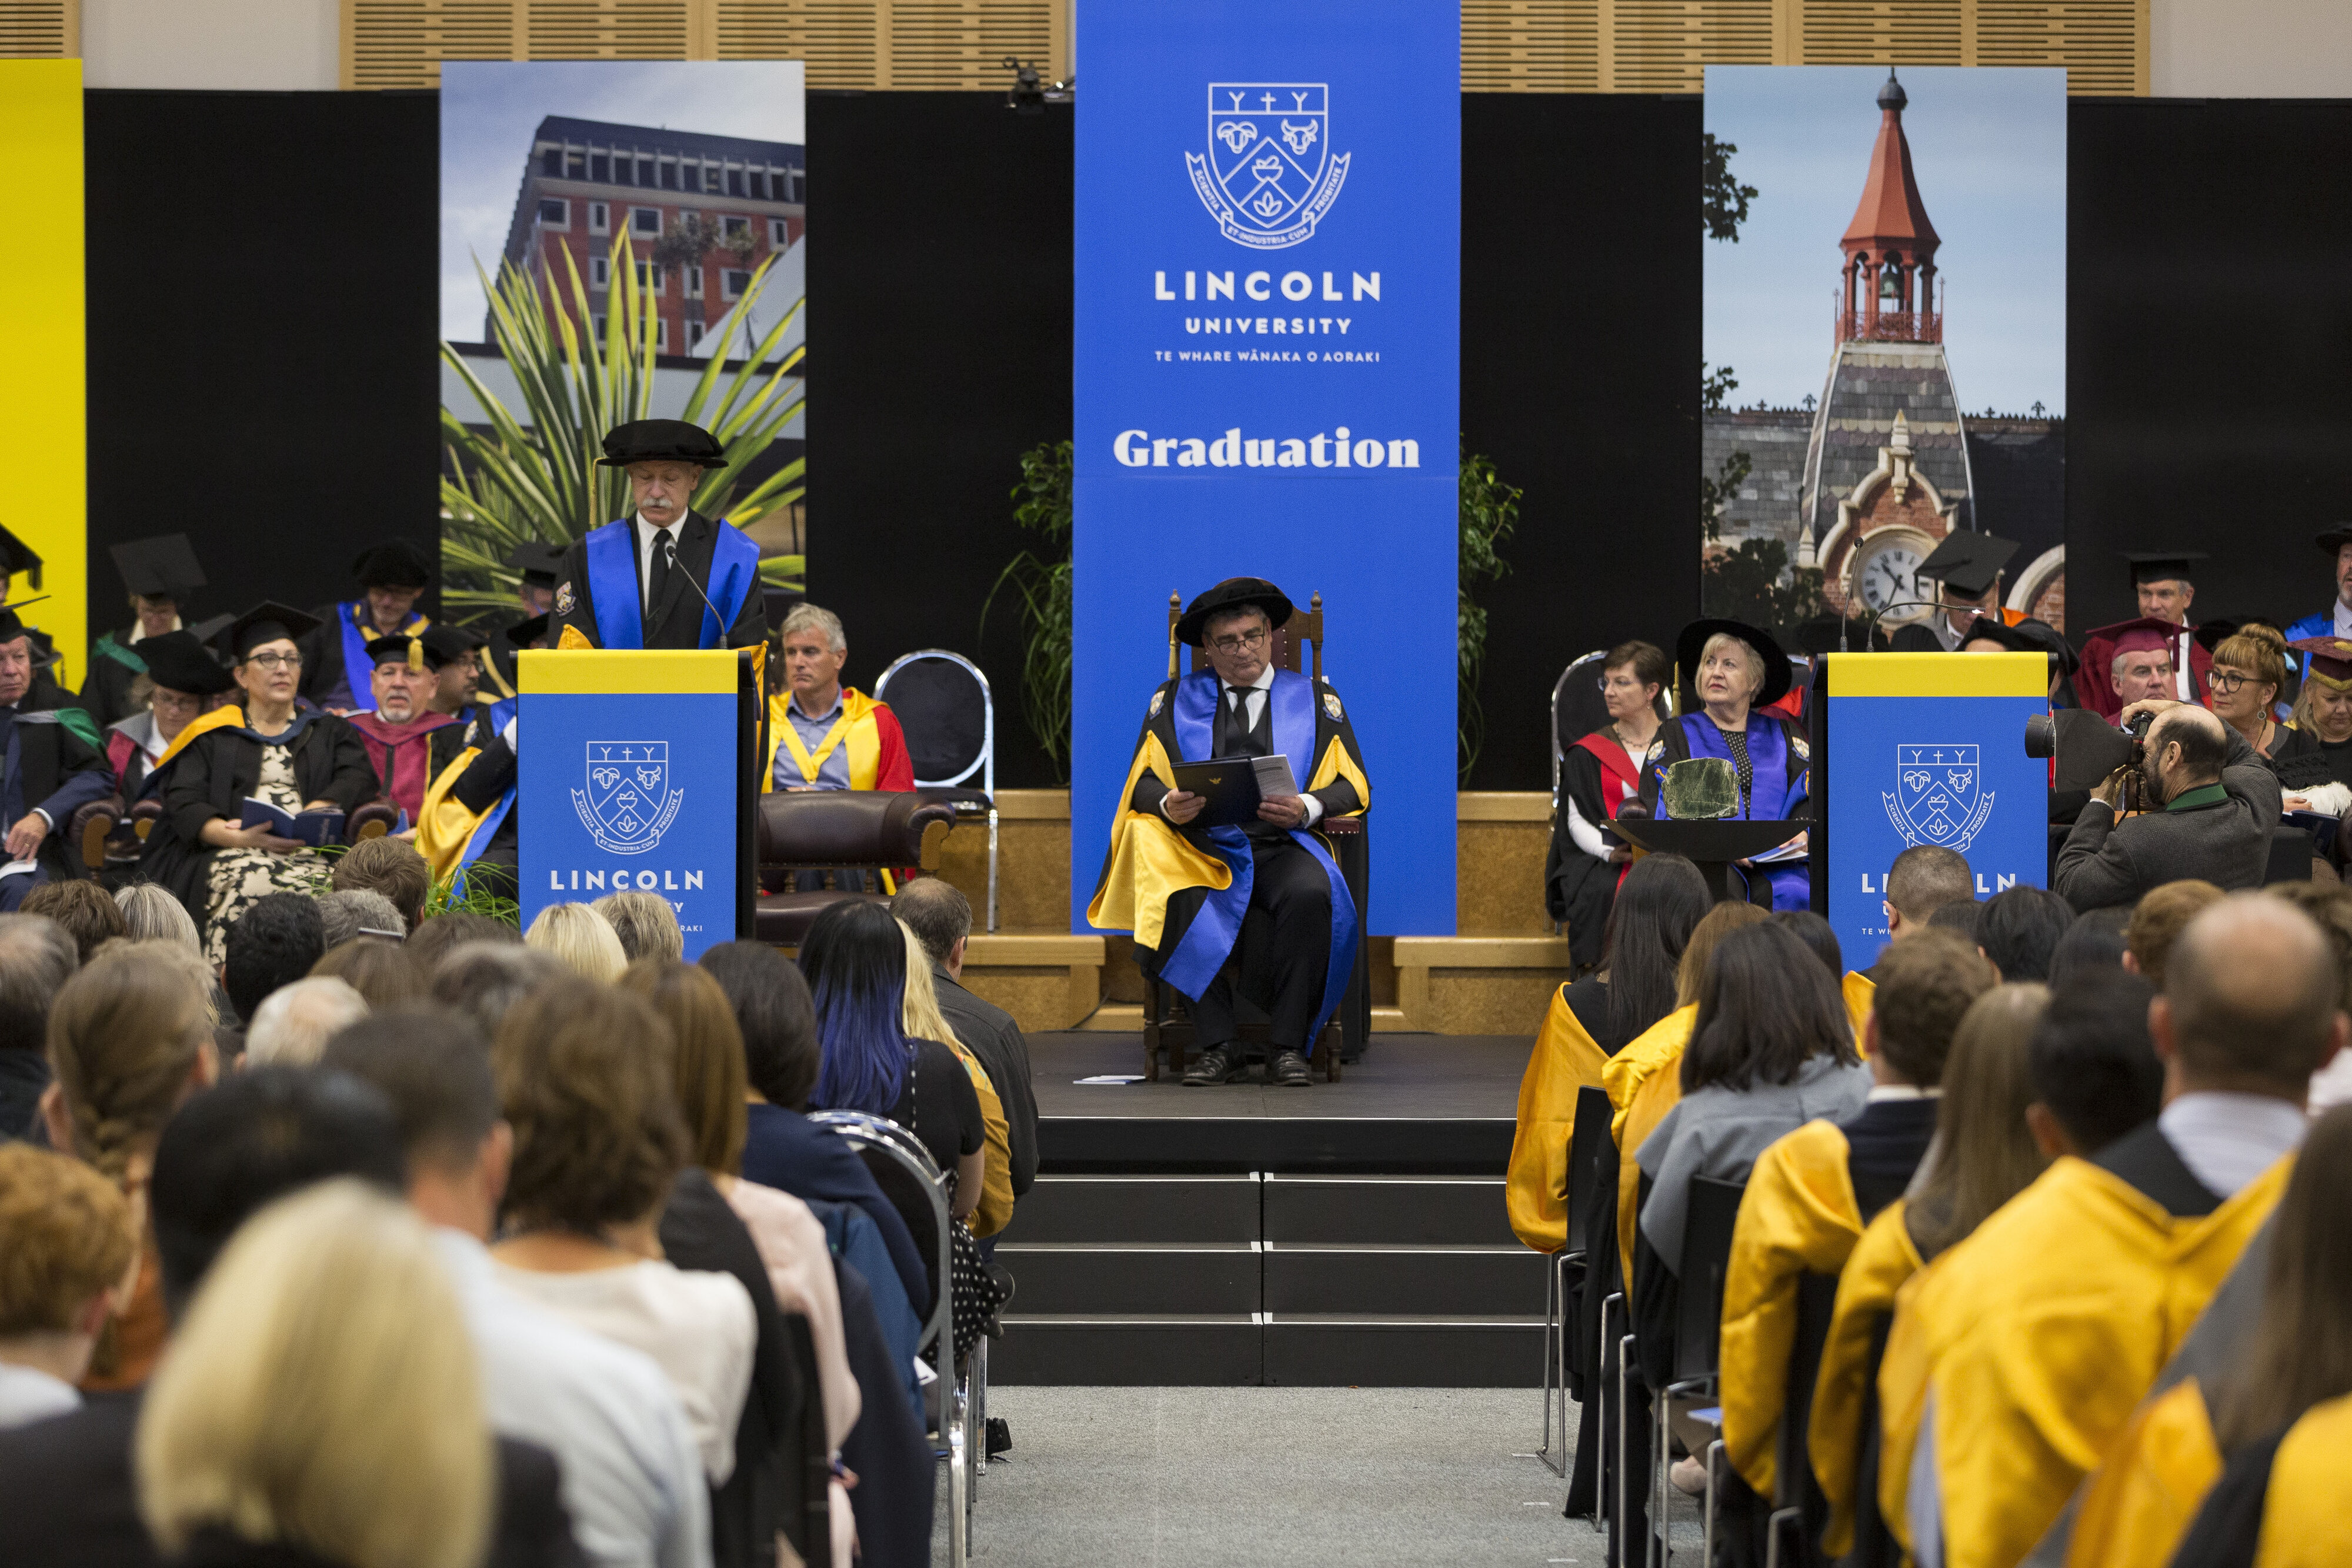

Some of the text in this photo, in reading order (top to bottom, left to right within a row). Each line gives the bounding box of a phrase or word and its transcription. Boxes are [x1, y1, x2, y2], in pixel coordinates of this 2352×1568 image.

[1195, 169, 1220, 211] SCIENTIA
[1314, 167, 1343, 212] PROBITATE
[1155, 271, 1380, 301] LINCOLN
[1185, 318, 1352, 335] UNIVERSITY
[1155, 351, 1172, 362] TE
[1179, 351, 1232, 362] WHARE
[1306, 351, 1317, 362] O
[1323, 351, 1380, 362] AORAKI
[1113, 426, 1420, 468] Graduation
[578, 800, 595, 828] SCIENTIA
[659, 798, 678, 829] PROBITATE
[1889, 803, 1906, 831] SCIENTIA
[1970, 802, 1989, 832] PROBITATE
[551, 870, 703, 890] LINCOLN
[1862, 873, 2016, 893] LILN
